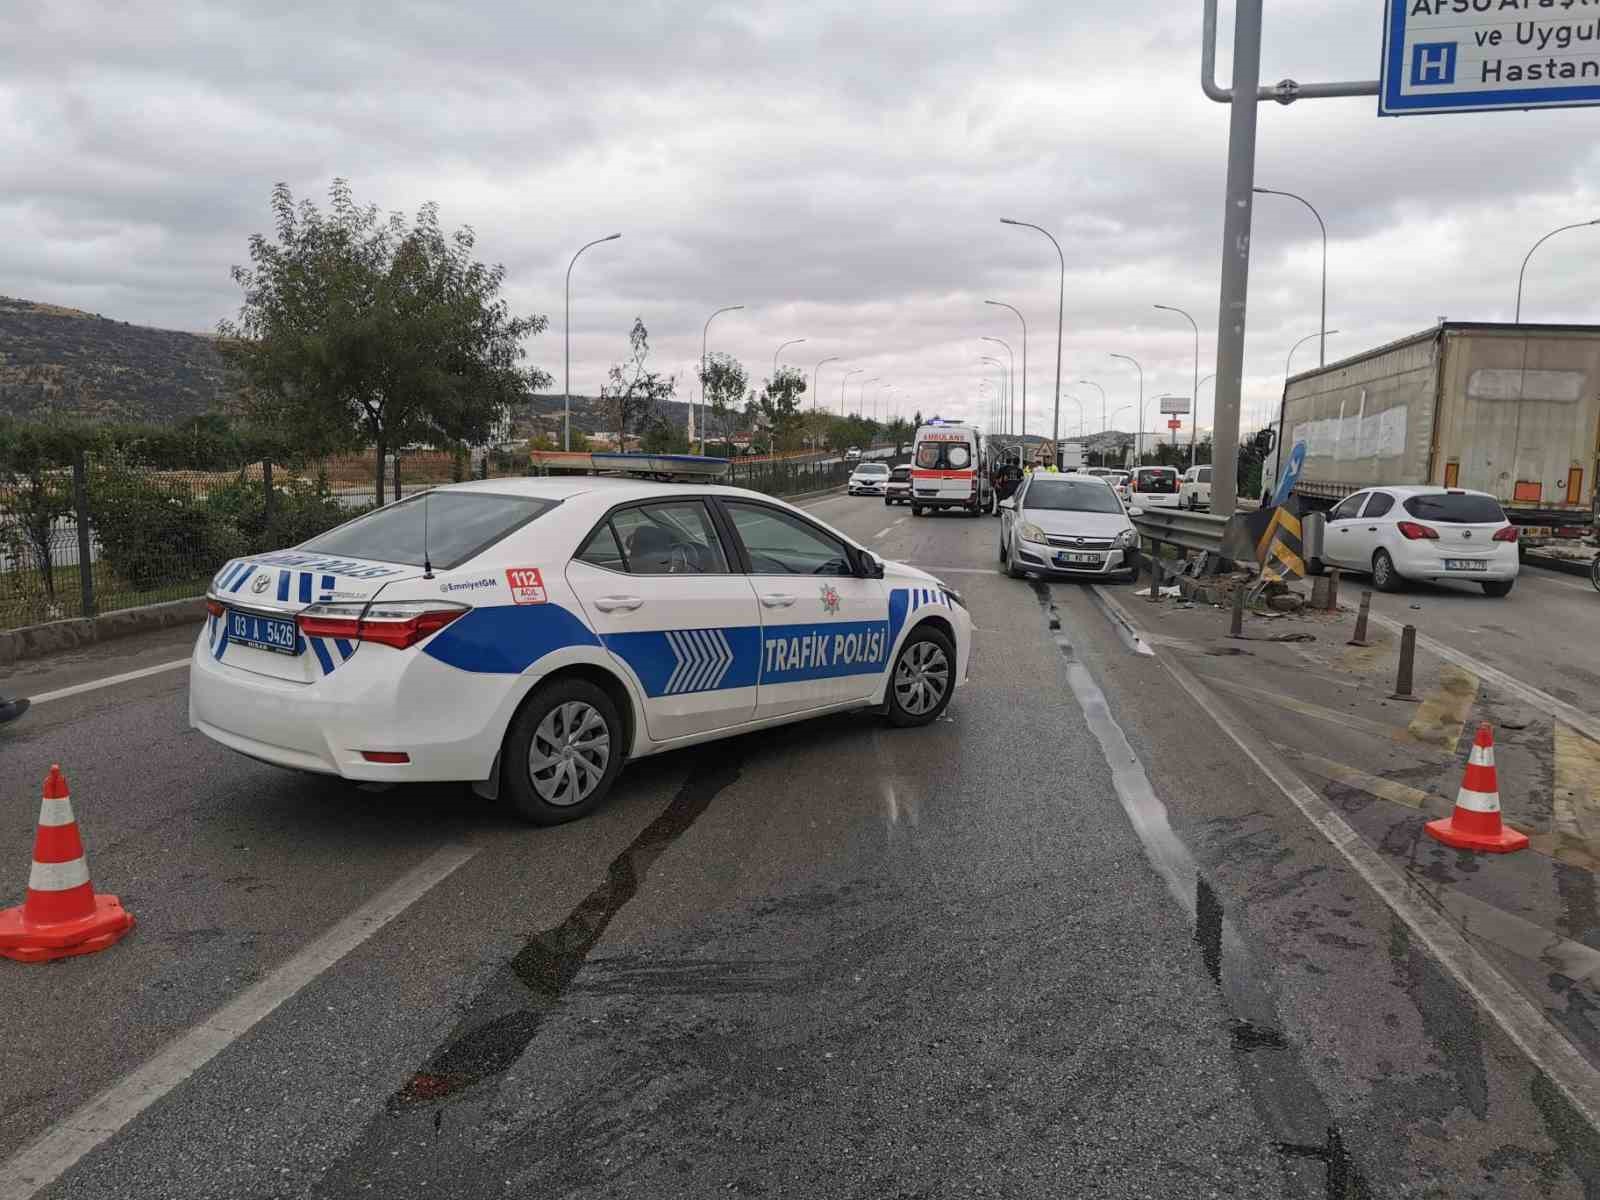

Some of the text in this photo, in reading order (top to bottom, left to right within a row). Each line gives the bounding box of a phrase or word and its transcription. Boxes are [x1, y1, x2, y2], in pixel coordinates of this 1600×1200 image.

[1474, 29, 1502, 47] ve
[1419, 48, 1448, 81] H
[1481, 58, 1600, 83] Hastan
[511, 571, 538, 586] 112
[235, 615, 247, 637] 03
[253, 619, 260, 641] A
[267, 621, 293, 646] 5426
[765, 627, 886, 673] TRAFİK POLİSİ
